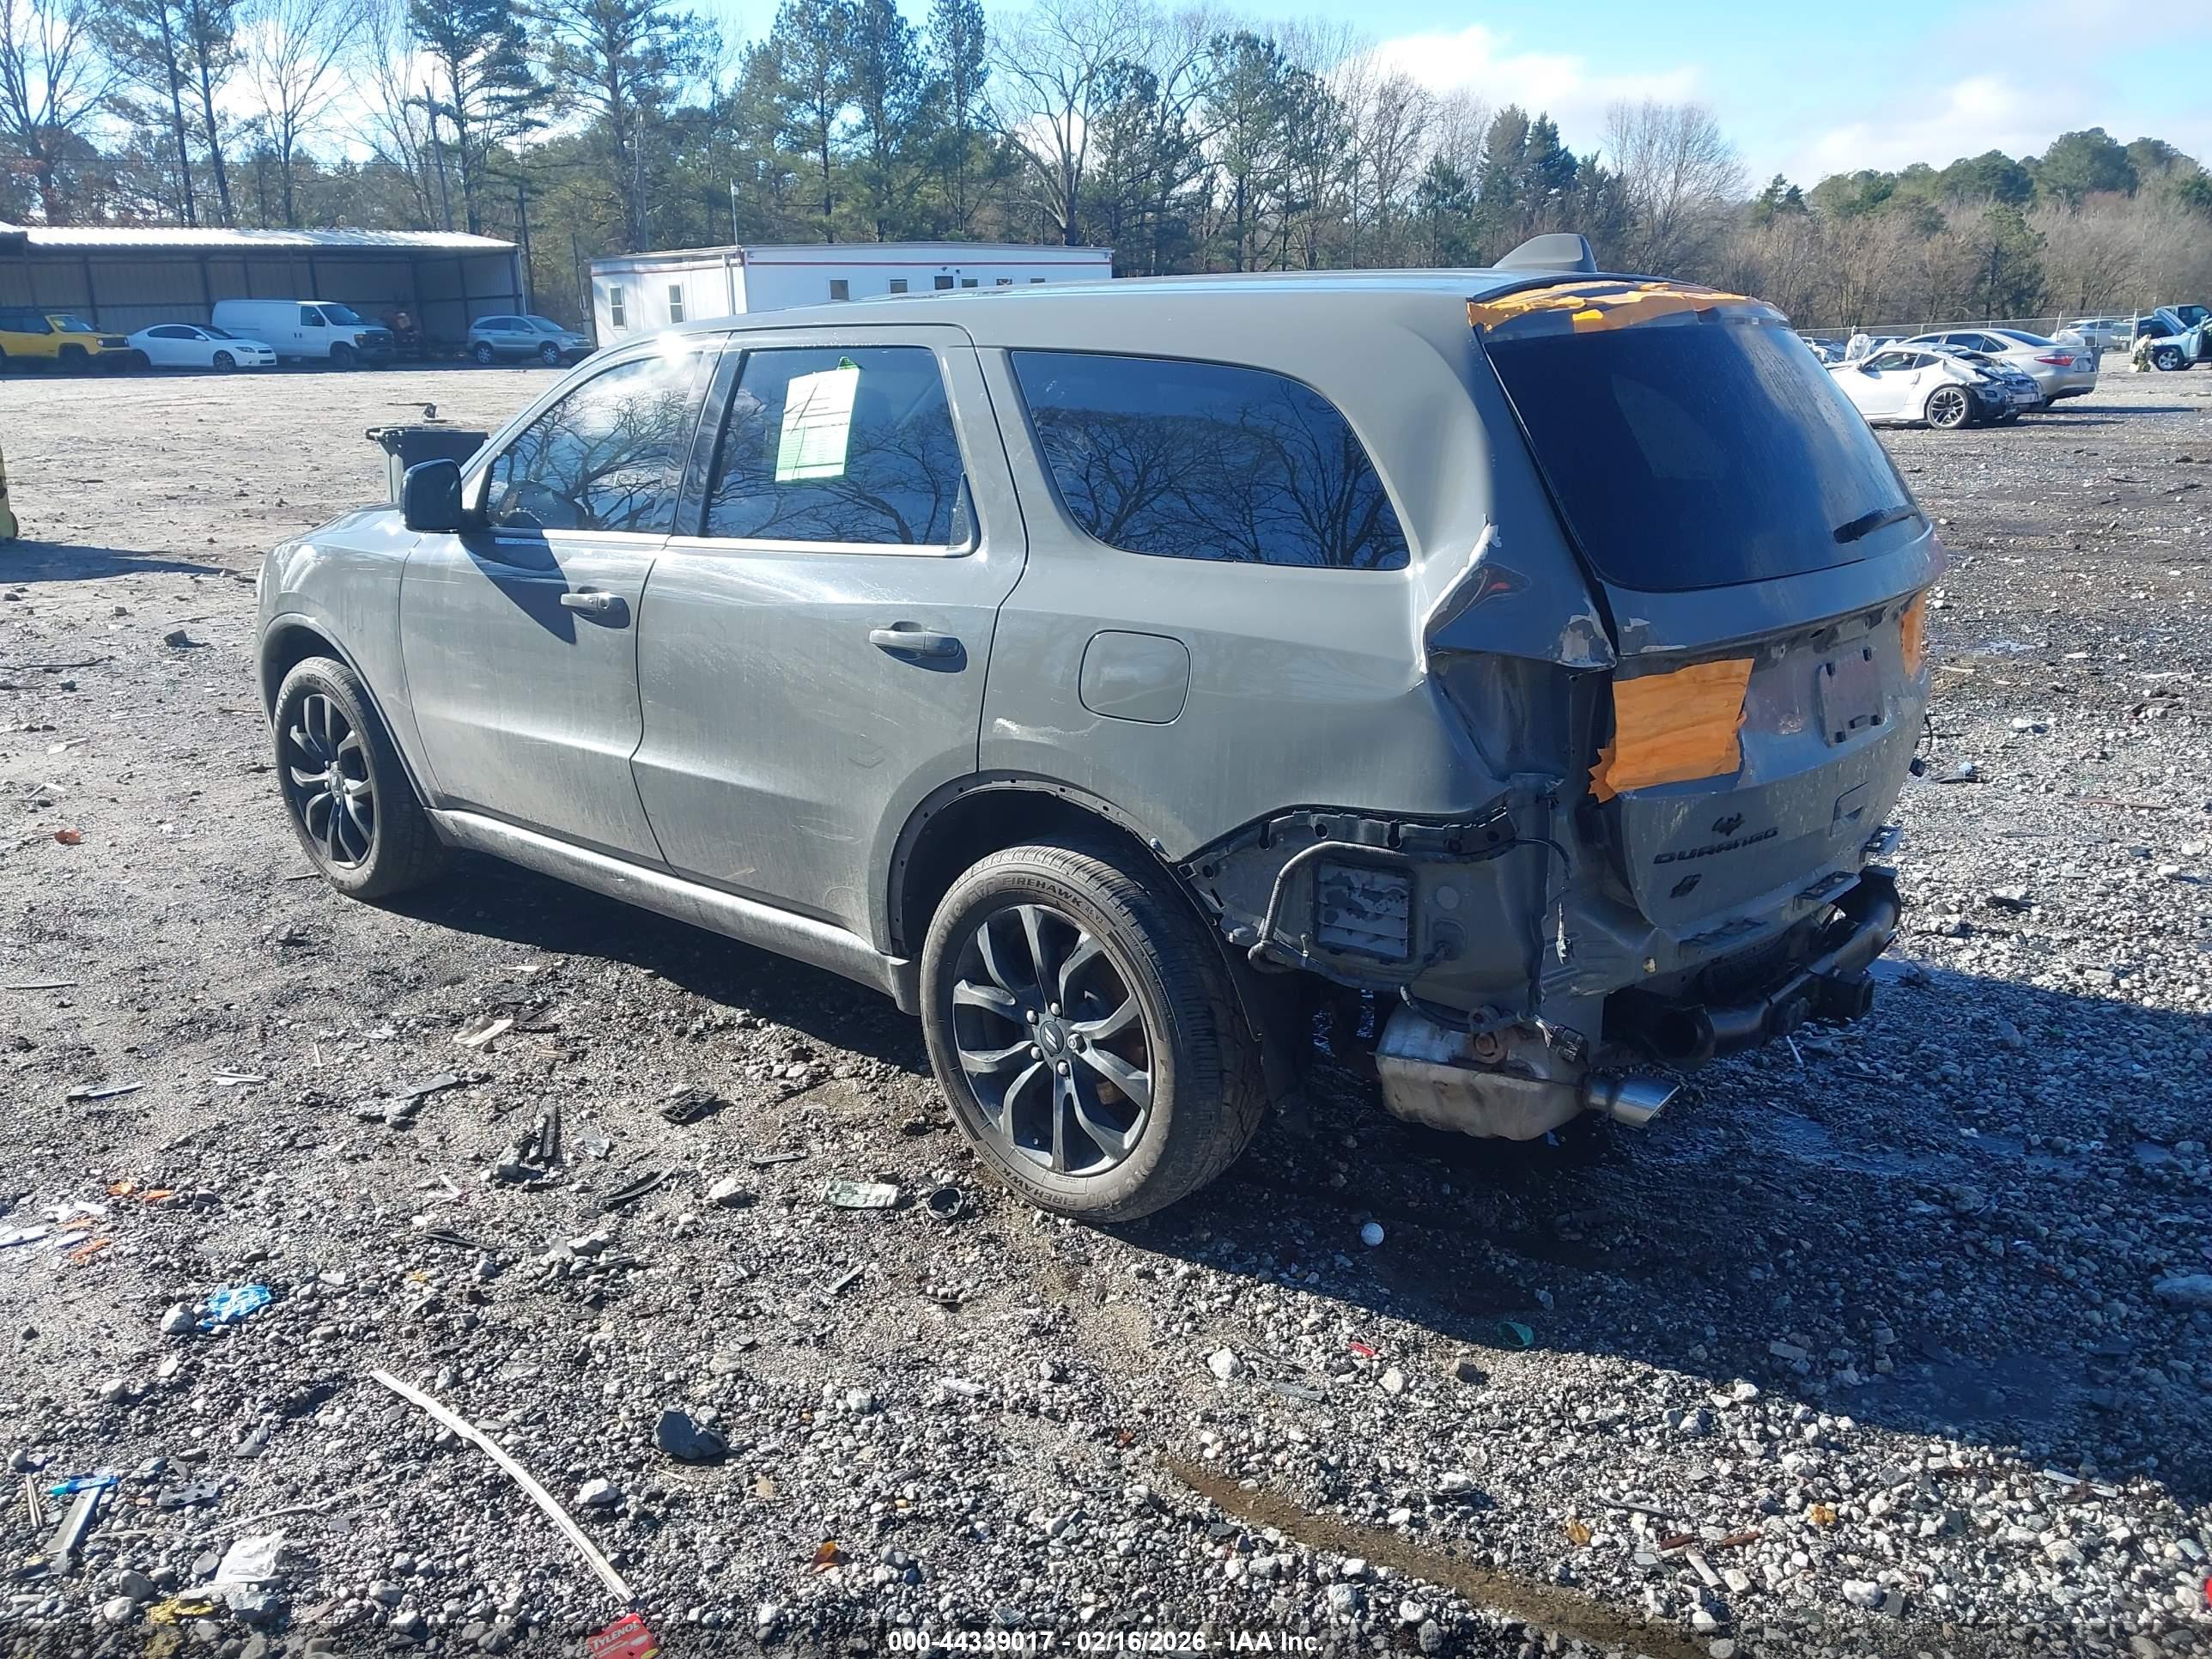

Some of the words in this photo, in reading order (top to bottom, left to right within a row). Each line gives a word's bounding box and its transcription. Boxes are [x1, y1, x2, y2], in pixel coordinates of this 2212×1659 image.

[1653, 827, 1780, 865] DURANGO
[1002, 877, 1083, 908] FIREHAWK
[1001, 1166, 1079, 1207] FIREHAWK
[592, 1620, 640, 1650] TYLENOL
